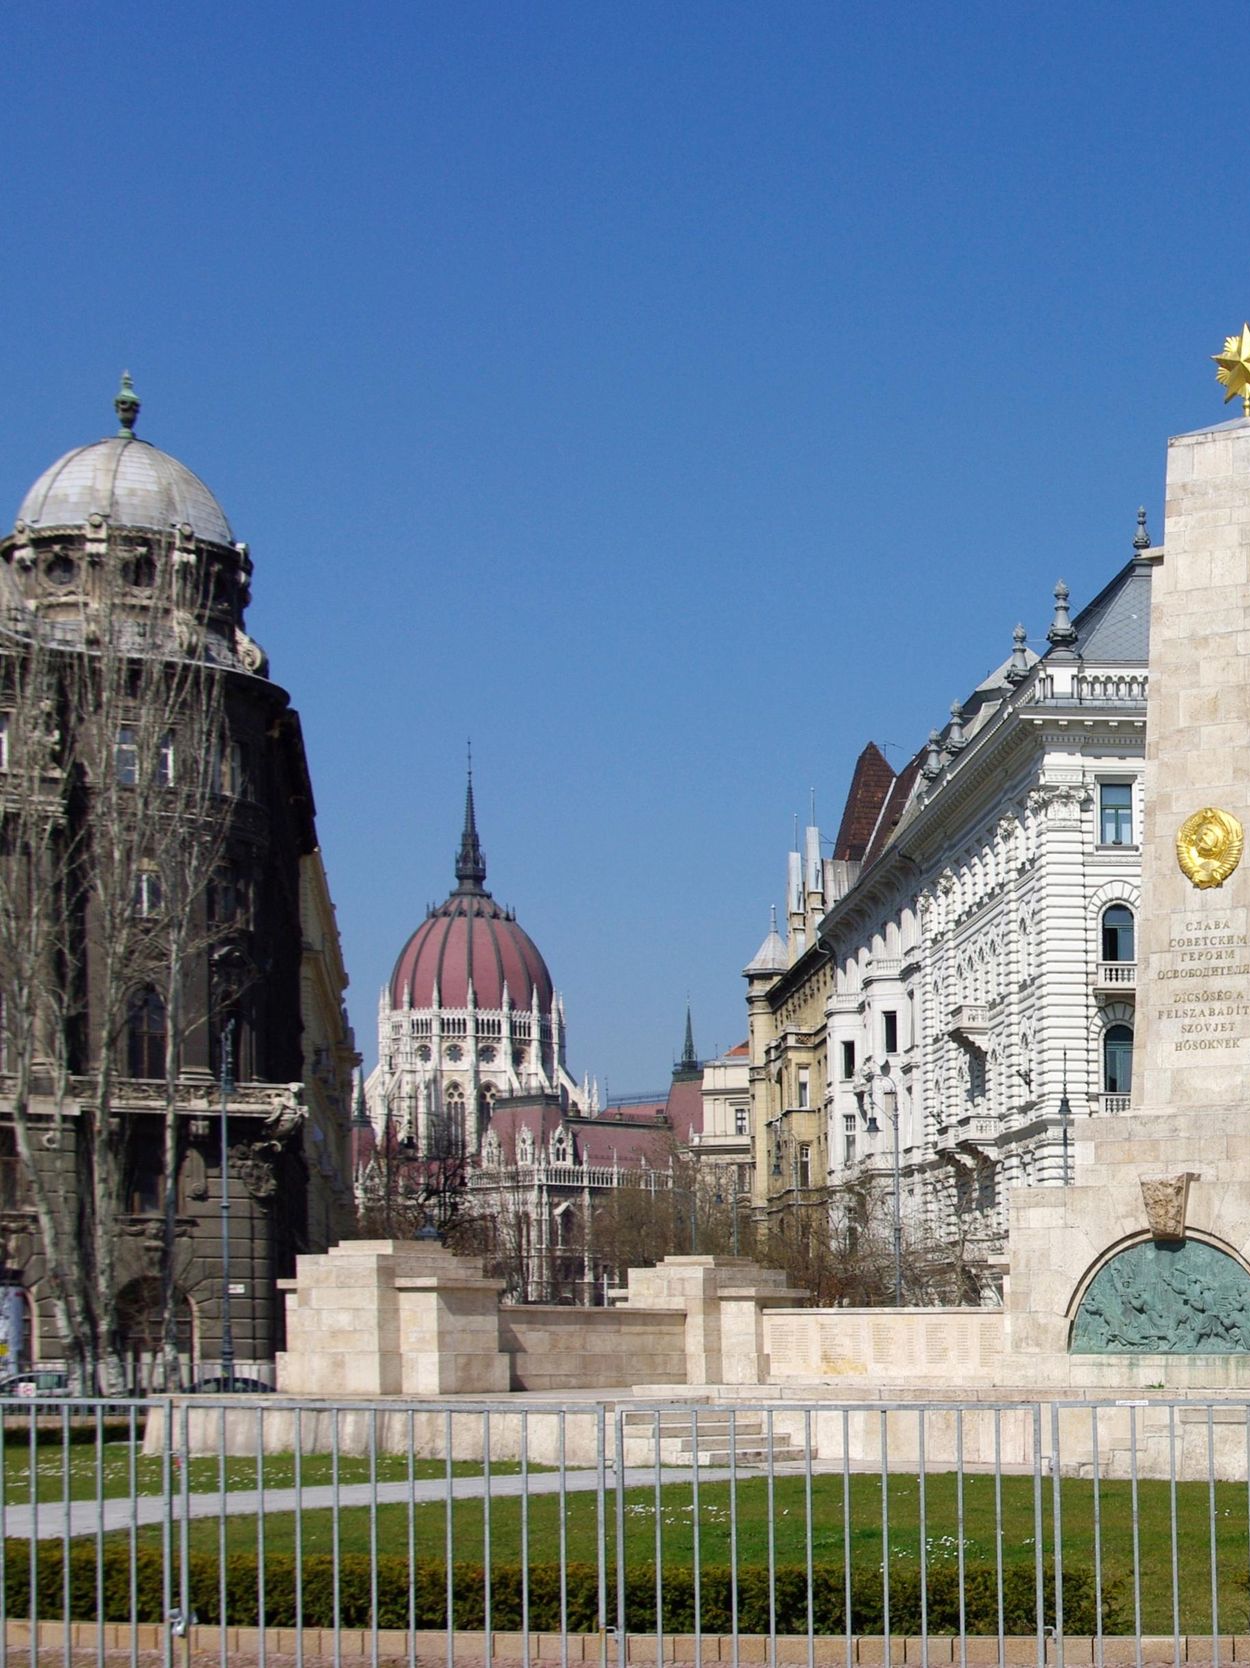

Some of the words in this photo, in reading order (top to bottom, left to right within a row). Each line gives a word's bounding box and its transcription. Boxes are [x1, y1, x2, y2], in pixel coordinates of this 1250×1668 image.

[1185, 920, 1231, 932] СЛАВА
[1169, 934, 1248, 948] СОВЕТСКИМ
[1181, 950, 1236, 962] ГЕРОЯМ
[1236, 991, 1244, 1000] A
[1181, 1023, 1236, 1034] SZOVJET
